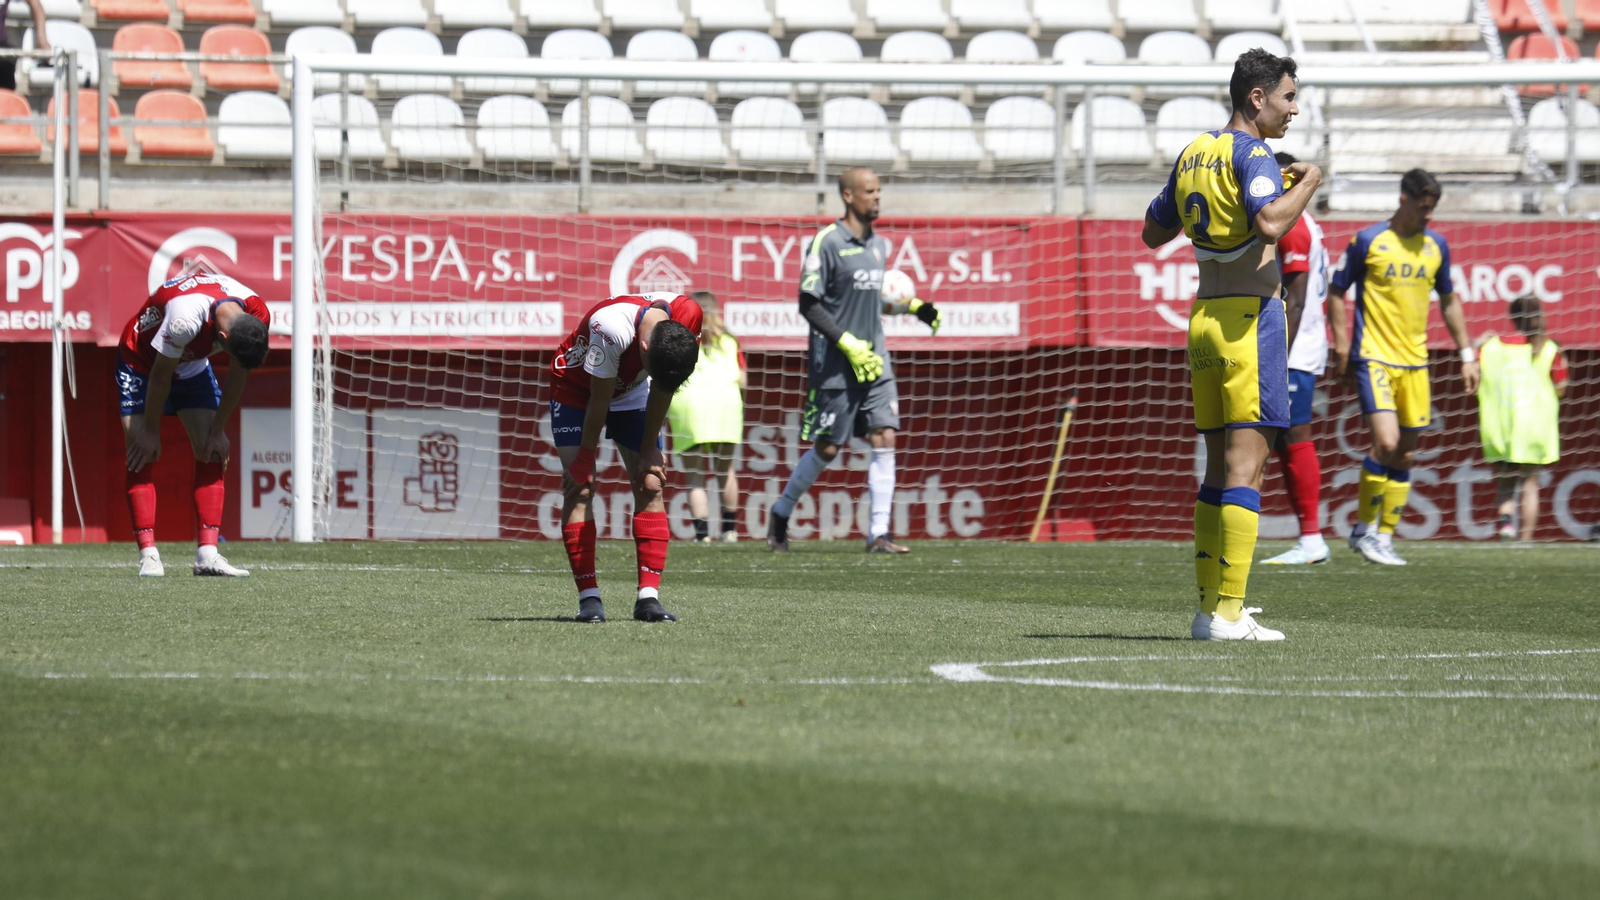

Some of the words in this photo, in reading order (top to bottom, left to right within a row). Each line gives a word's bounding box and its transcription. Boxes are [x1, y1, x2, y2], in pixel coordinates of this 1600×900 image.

[6, 248, 80, 303] pp
[491, 250, 556, 282] S.L.
[732, 235, 944, 292] FYA,
[948, 251, 1012, 283] S.L.
[1384, 262, 1427, 279] ADA
[1429, 264, 1564, 303] AROC
[390, 311, 401, 326] Y
[411, 310, 555, 327] ESTRUCTURAS
[252, 451, 292, 463] ALGECI
[252, 470, 358, 508] PE
